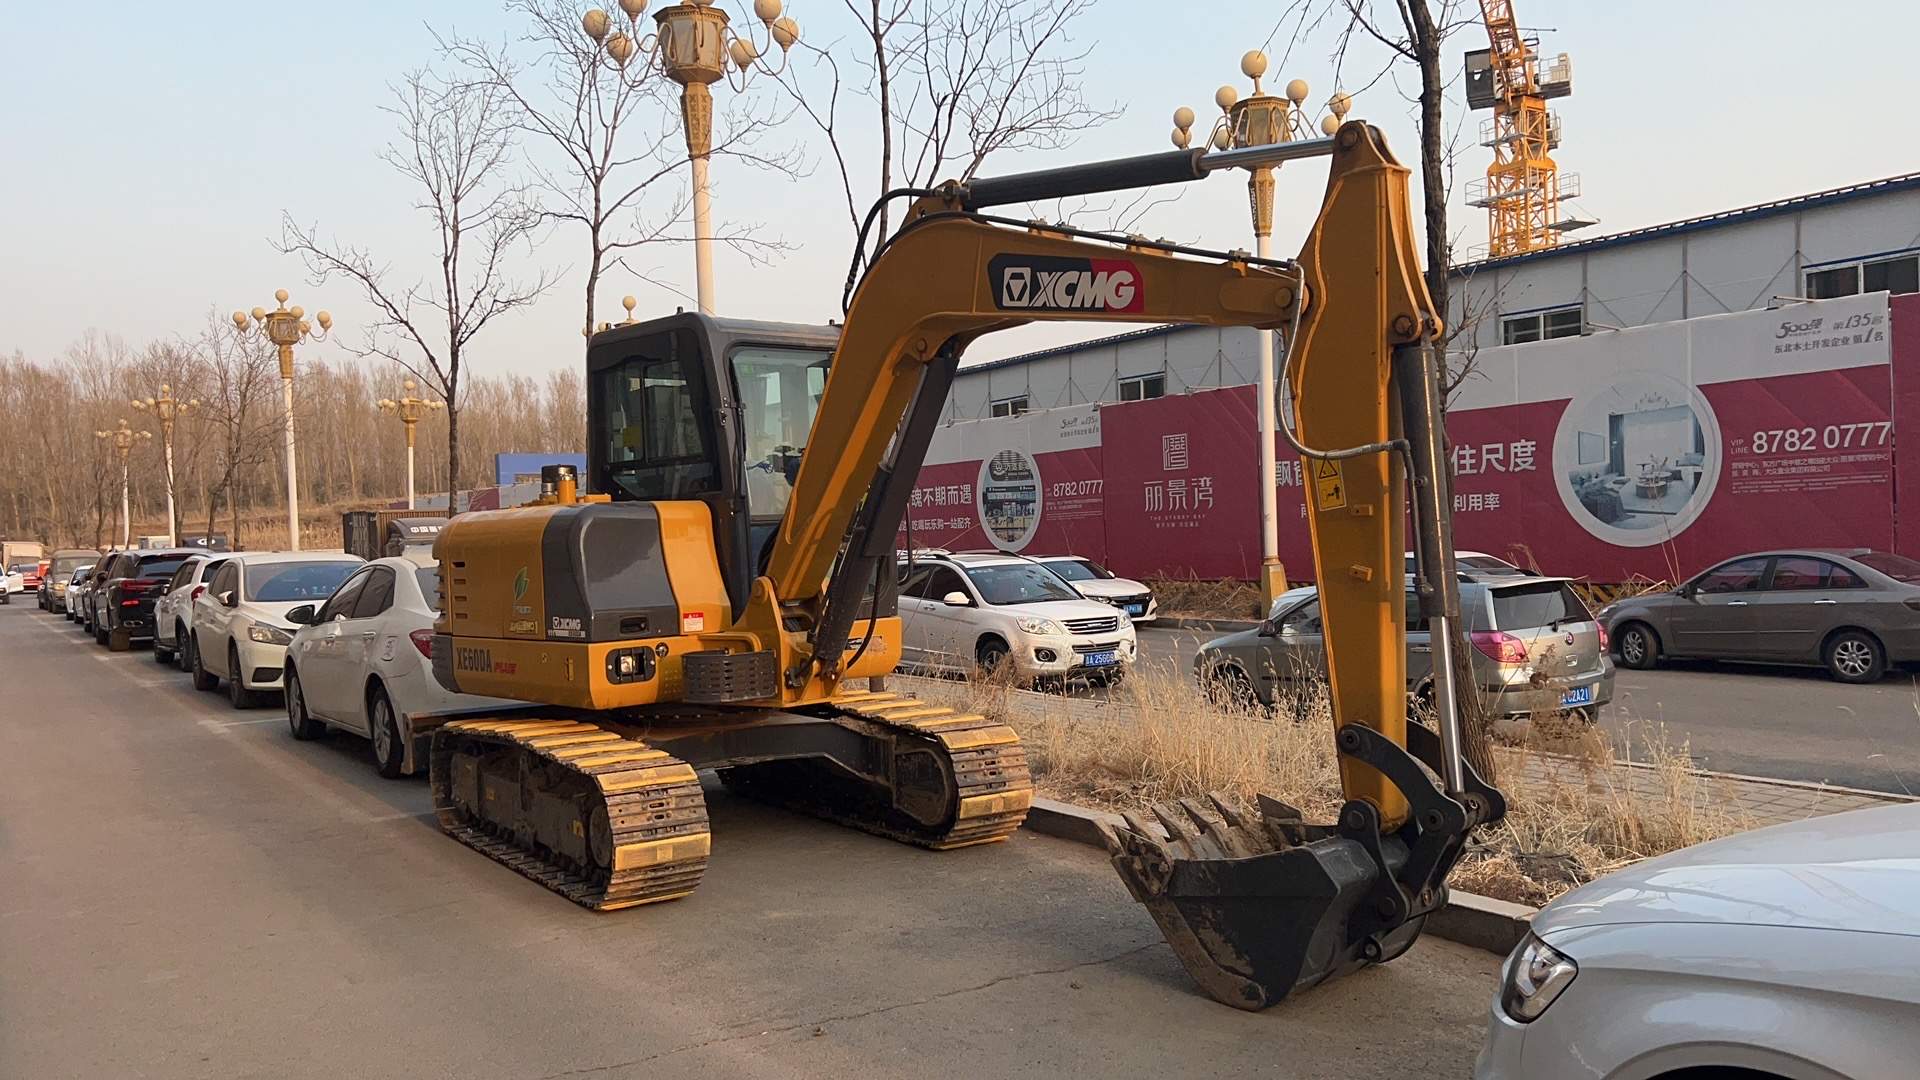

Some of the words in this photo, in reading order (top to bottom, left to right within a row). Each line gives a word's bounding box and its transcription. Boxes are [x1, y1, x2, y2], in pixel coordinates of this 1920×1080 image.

[1029, 270, 1136, 310] XCMG
[1730, 439, 1744, 447] VIP
[1730, 446, 1749, 455] LINE
[1752, 428, 1817, 454] 8782
[1823, 421, 1892, 449] 0777
[1053, 481, 1078, 497] 8782
[1078, 479, 1104, 496] 0777
[1143, 476, 1213, 512] 丽景湾
[456, 647, 493, 673] XE60DA
